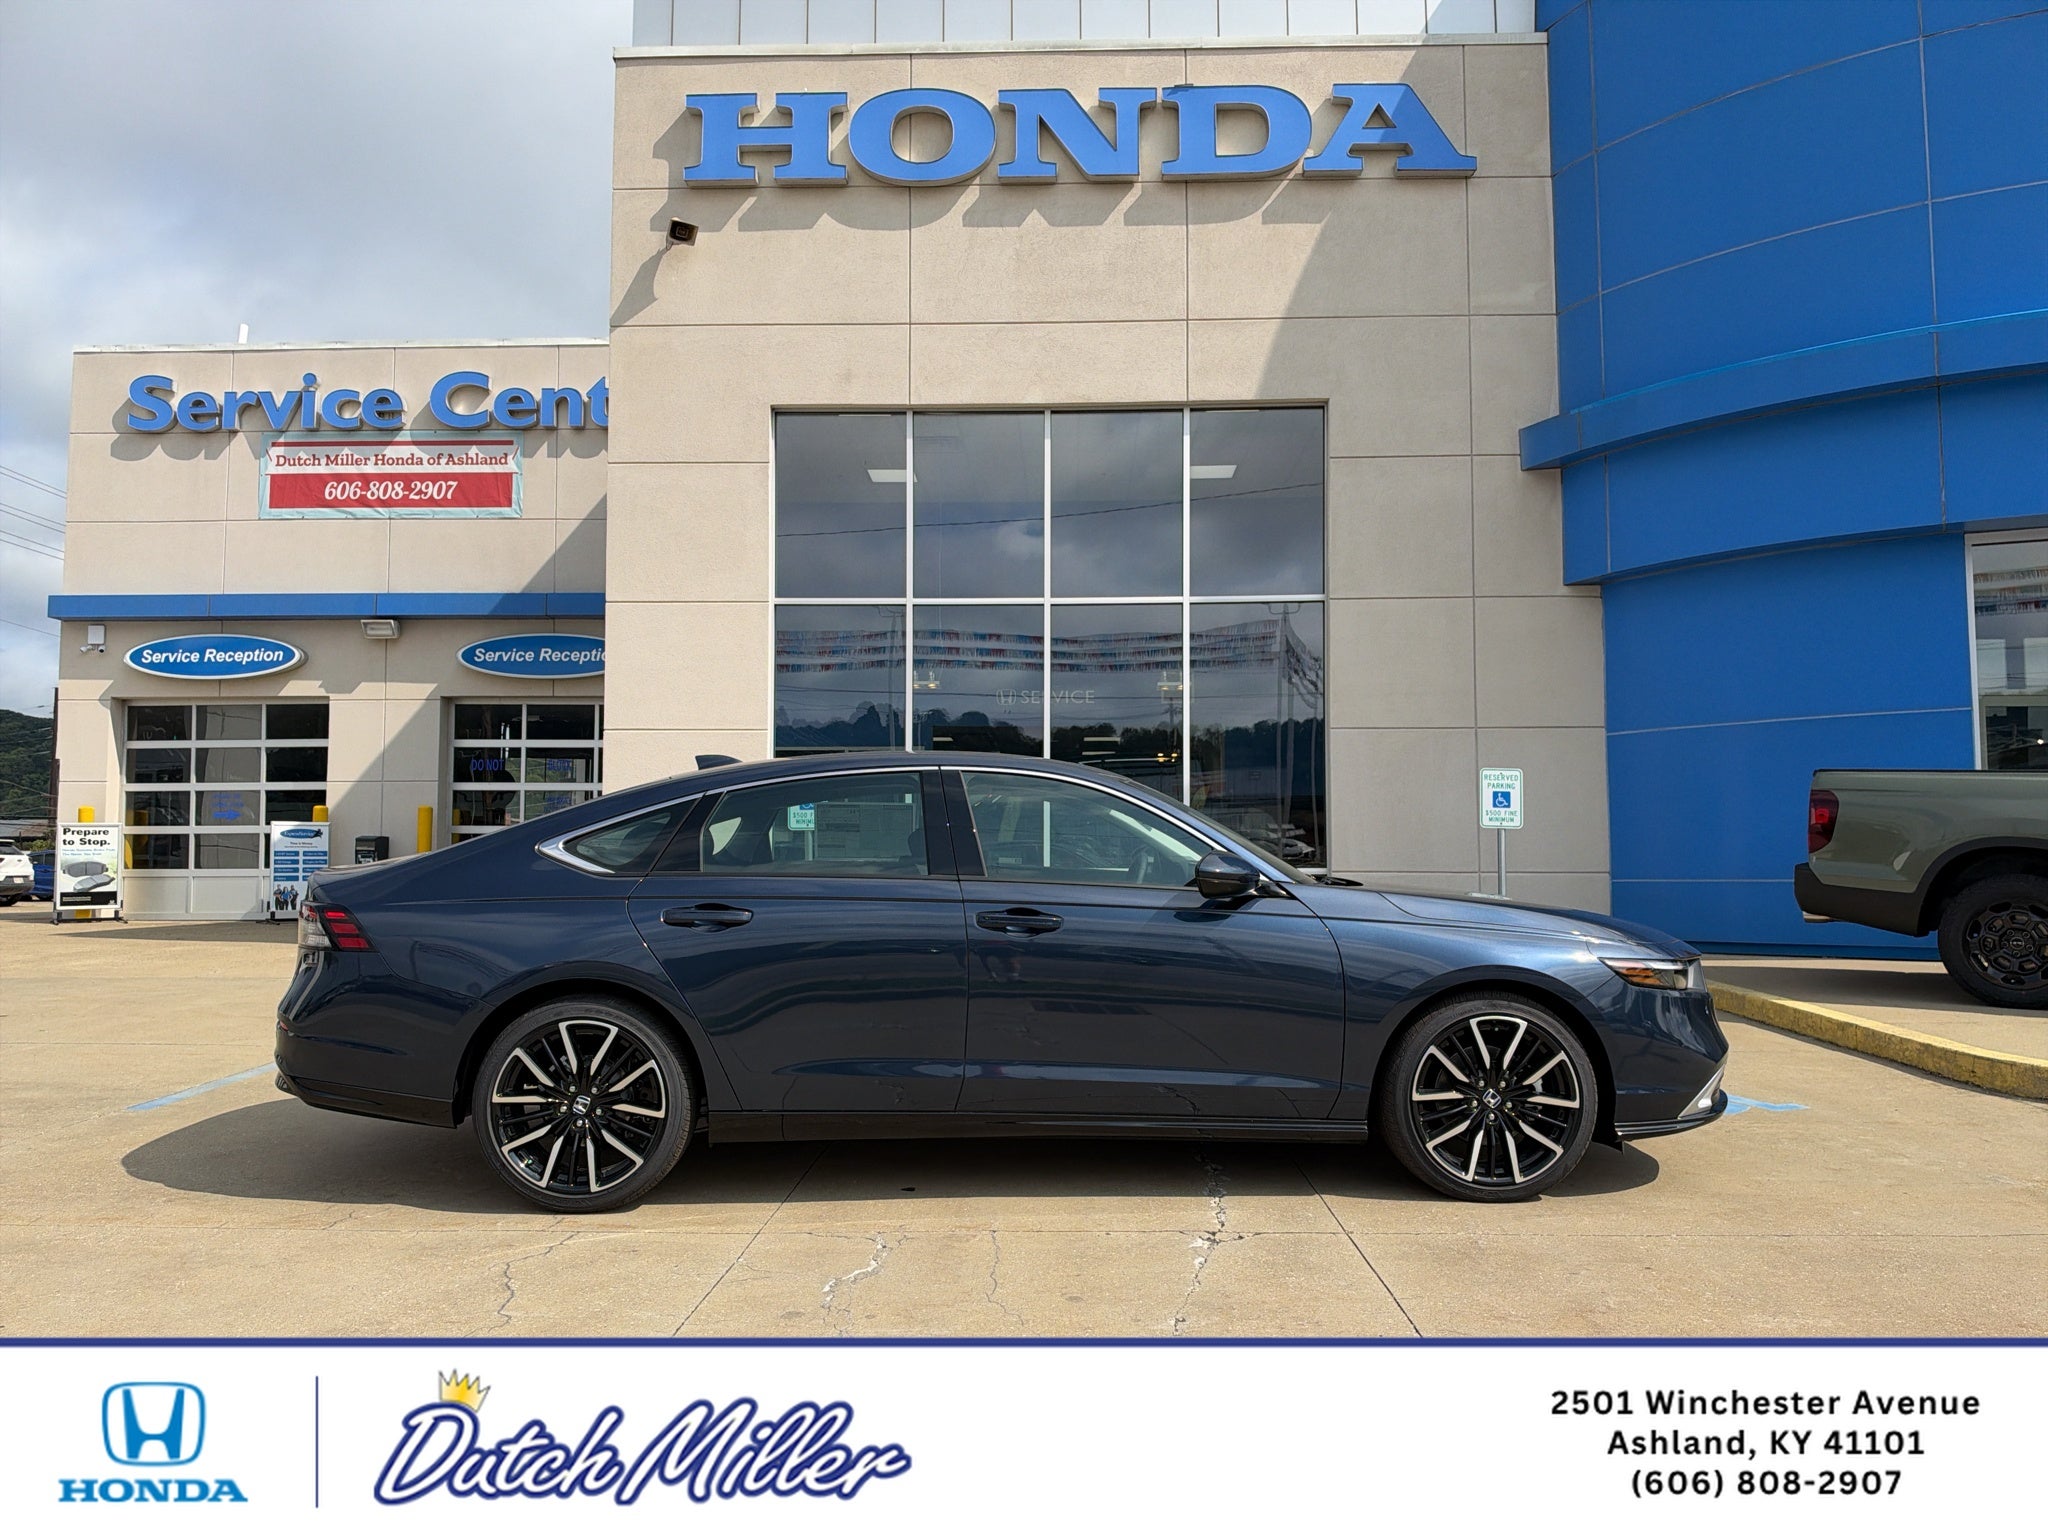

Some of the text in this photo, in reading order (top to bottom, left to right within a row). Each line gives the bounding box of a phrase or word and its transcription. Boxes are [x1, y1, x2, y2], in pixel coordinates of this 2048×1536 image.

[683, 83, 1477, 187] HONDA
[127, 372, 404, 432] Service
[275, 452, 509, 467] Dutch Miller Honda of Ashland
[324, 480, 458, 500] 606-808-2907
[141, 648, 284, 665] Service Reception
[474, 647, 534, 662] Service
[1020, 690, 1095, 704] SEVICE
[486, 760, 504, 771] NOT
[1484, 773, 1519, 781] RESERVED
[1487, 782, 1516, 790] PARKING
[63, 827, 109, 837] Prepare
[79, 837, 110, 847] Stop.
